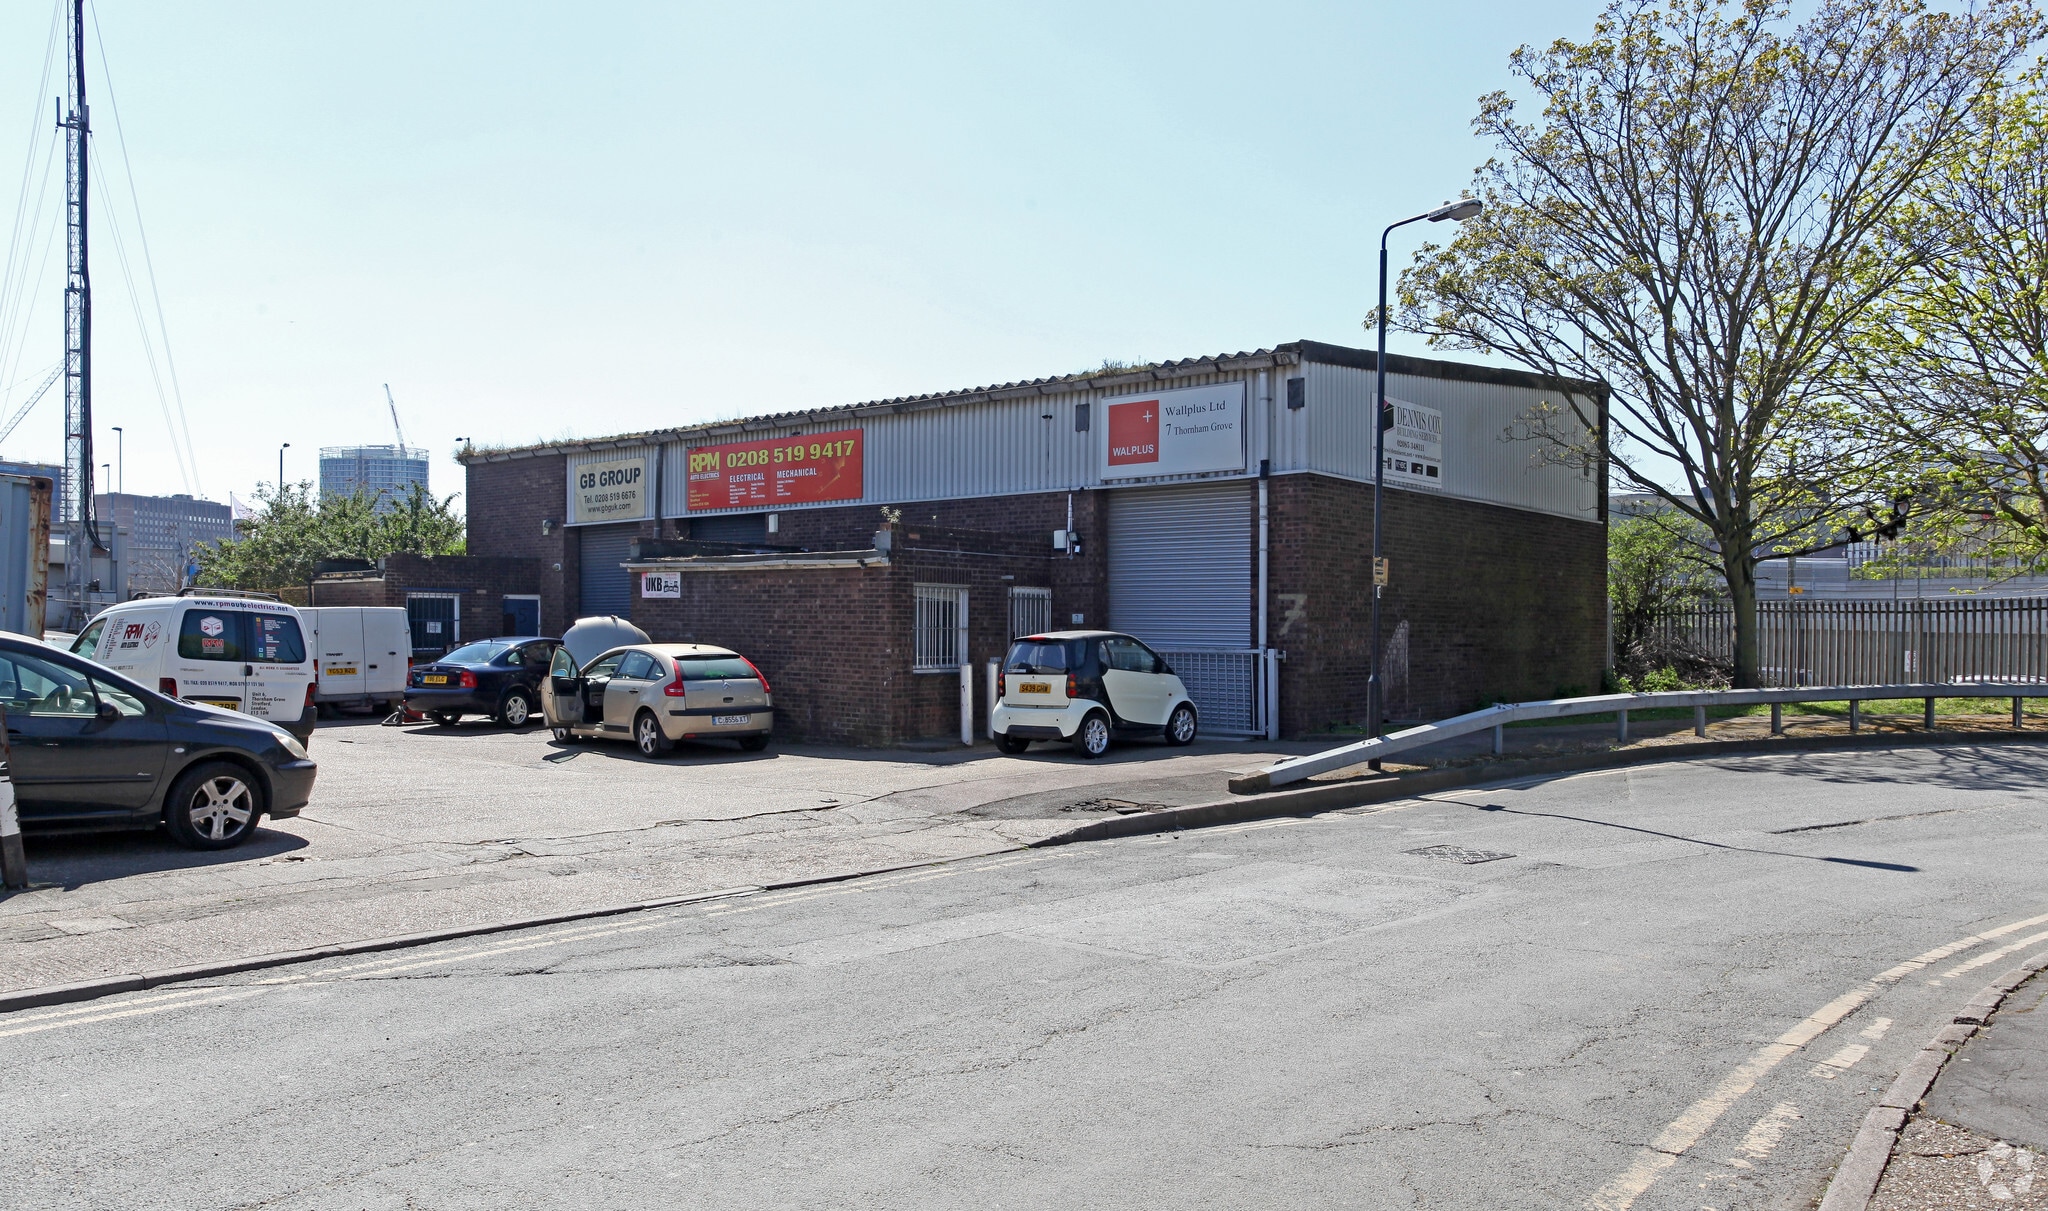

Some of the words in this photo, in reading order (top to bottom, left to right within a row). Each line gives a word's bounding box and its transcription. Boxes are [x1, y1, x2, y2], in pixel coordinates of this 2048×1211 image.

[1165, 404, 1207, 417] Wallplus
[1210, 400, 1226, 412] Ltd
[1397, 406, 1426, 430] DENNIS
[1428, 414, 1442, 434] COX
[1166, 424, 1172, 436] 7
[1174, 424, 1209, 436] Thornham
[1210, 422, 1232, 432] Grove
[1396, 426, 1418, 440] BUILDING
[1419, 432, 1438, 444] SERVICES
[726, 448, 769, 468] 0208
[774, 445, 804, 464] 519
[810, 440, 854, 460] 9417
[1112, 444, 1154, 456] WALPLUS
[690, 452, 720, 472] RPM
[580, 472, 596, 489] GB
[599, 467, 641, 487] GROUP
[730, 472, 764, 483] ELECTRICAL
[776, 468, 817, 478] MECHANICAL
[584, 495, 593, 504] Tel.
[594, 494, 608, 503] 0208
[609, 492, 620, 501] 519
[621, 490, 636, 500] 6676
[588, 503, 631, 513] www.gbguk.com
[646, 577, 662, 592] UKB
[194, 600, 288, 612] www.rpmautoelectrics.net
[1278, 594, 1307, 636] 7
[123, 623, 145, 639] RPM
[202, 638, 224, 647] RPM
